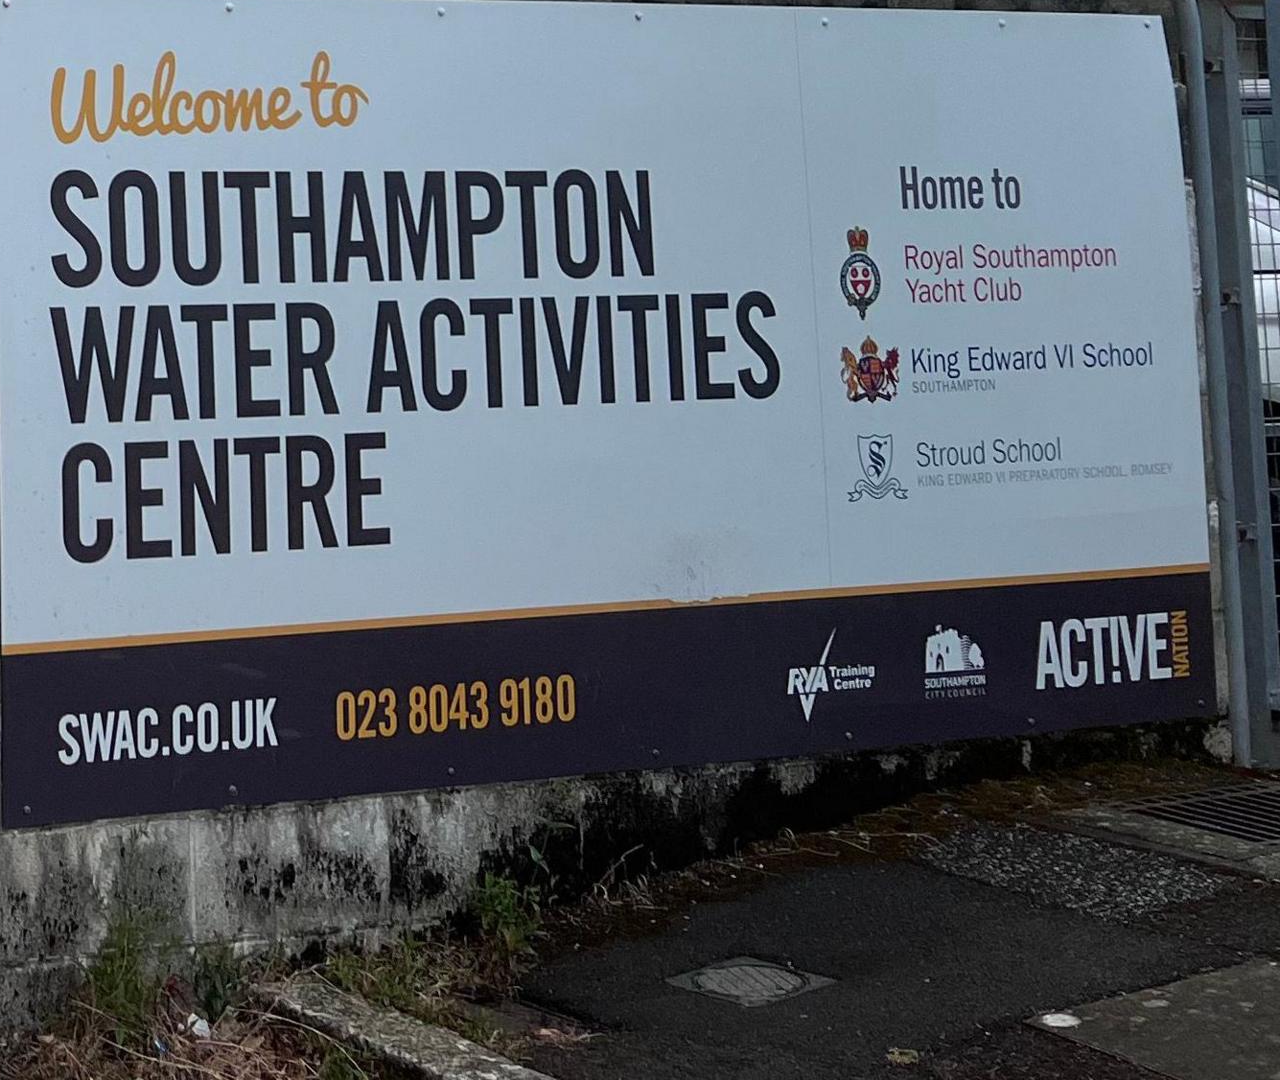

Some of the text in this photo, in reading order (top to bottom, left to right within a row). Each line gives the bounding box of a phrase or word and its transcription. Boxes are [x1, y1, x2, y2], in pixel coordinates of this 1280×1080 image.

[50, 50, 370, 144] Welcome to
[899, 166, 1022, 210] Home to
[49, 168, 656, 288] SOUTHAMPTON
[904, 243, 1118, 275] Royal Southampton
[905, 278, 967, 303] Yacht
[973, 277, 1023, 302] Club
[48, 290, 782, 424] WATER ACTIVITIES
[911, 341, 1154, 379] King Edward VI School
[911, 379, 997, 394] SOUTHAMPTON
[916, 437, 1063, 468] Stroud School
[917, 474, 945, 488] KING
[947, 472, 992, 487] EDWARD
[996, 471, 1007, 484] VI
[1009, 468, 1081, 483] PREPARATORY
[1130, 462, 1174, 477] ROMSEY
[60, 431, 392, 564] CENTRE
[1171, 610, 1191, 678] NATION
[829, 664, 876, 678] Training
[834, 677, 872, 691] Centre
[924, 674, 987, 690] SOUTHAMPTON
[925, 687, 987, 700] CITY COUNCIL
[57, 673, 577, 766] SWAC.CO.UK 023 8043 9180
